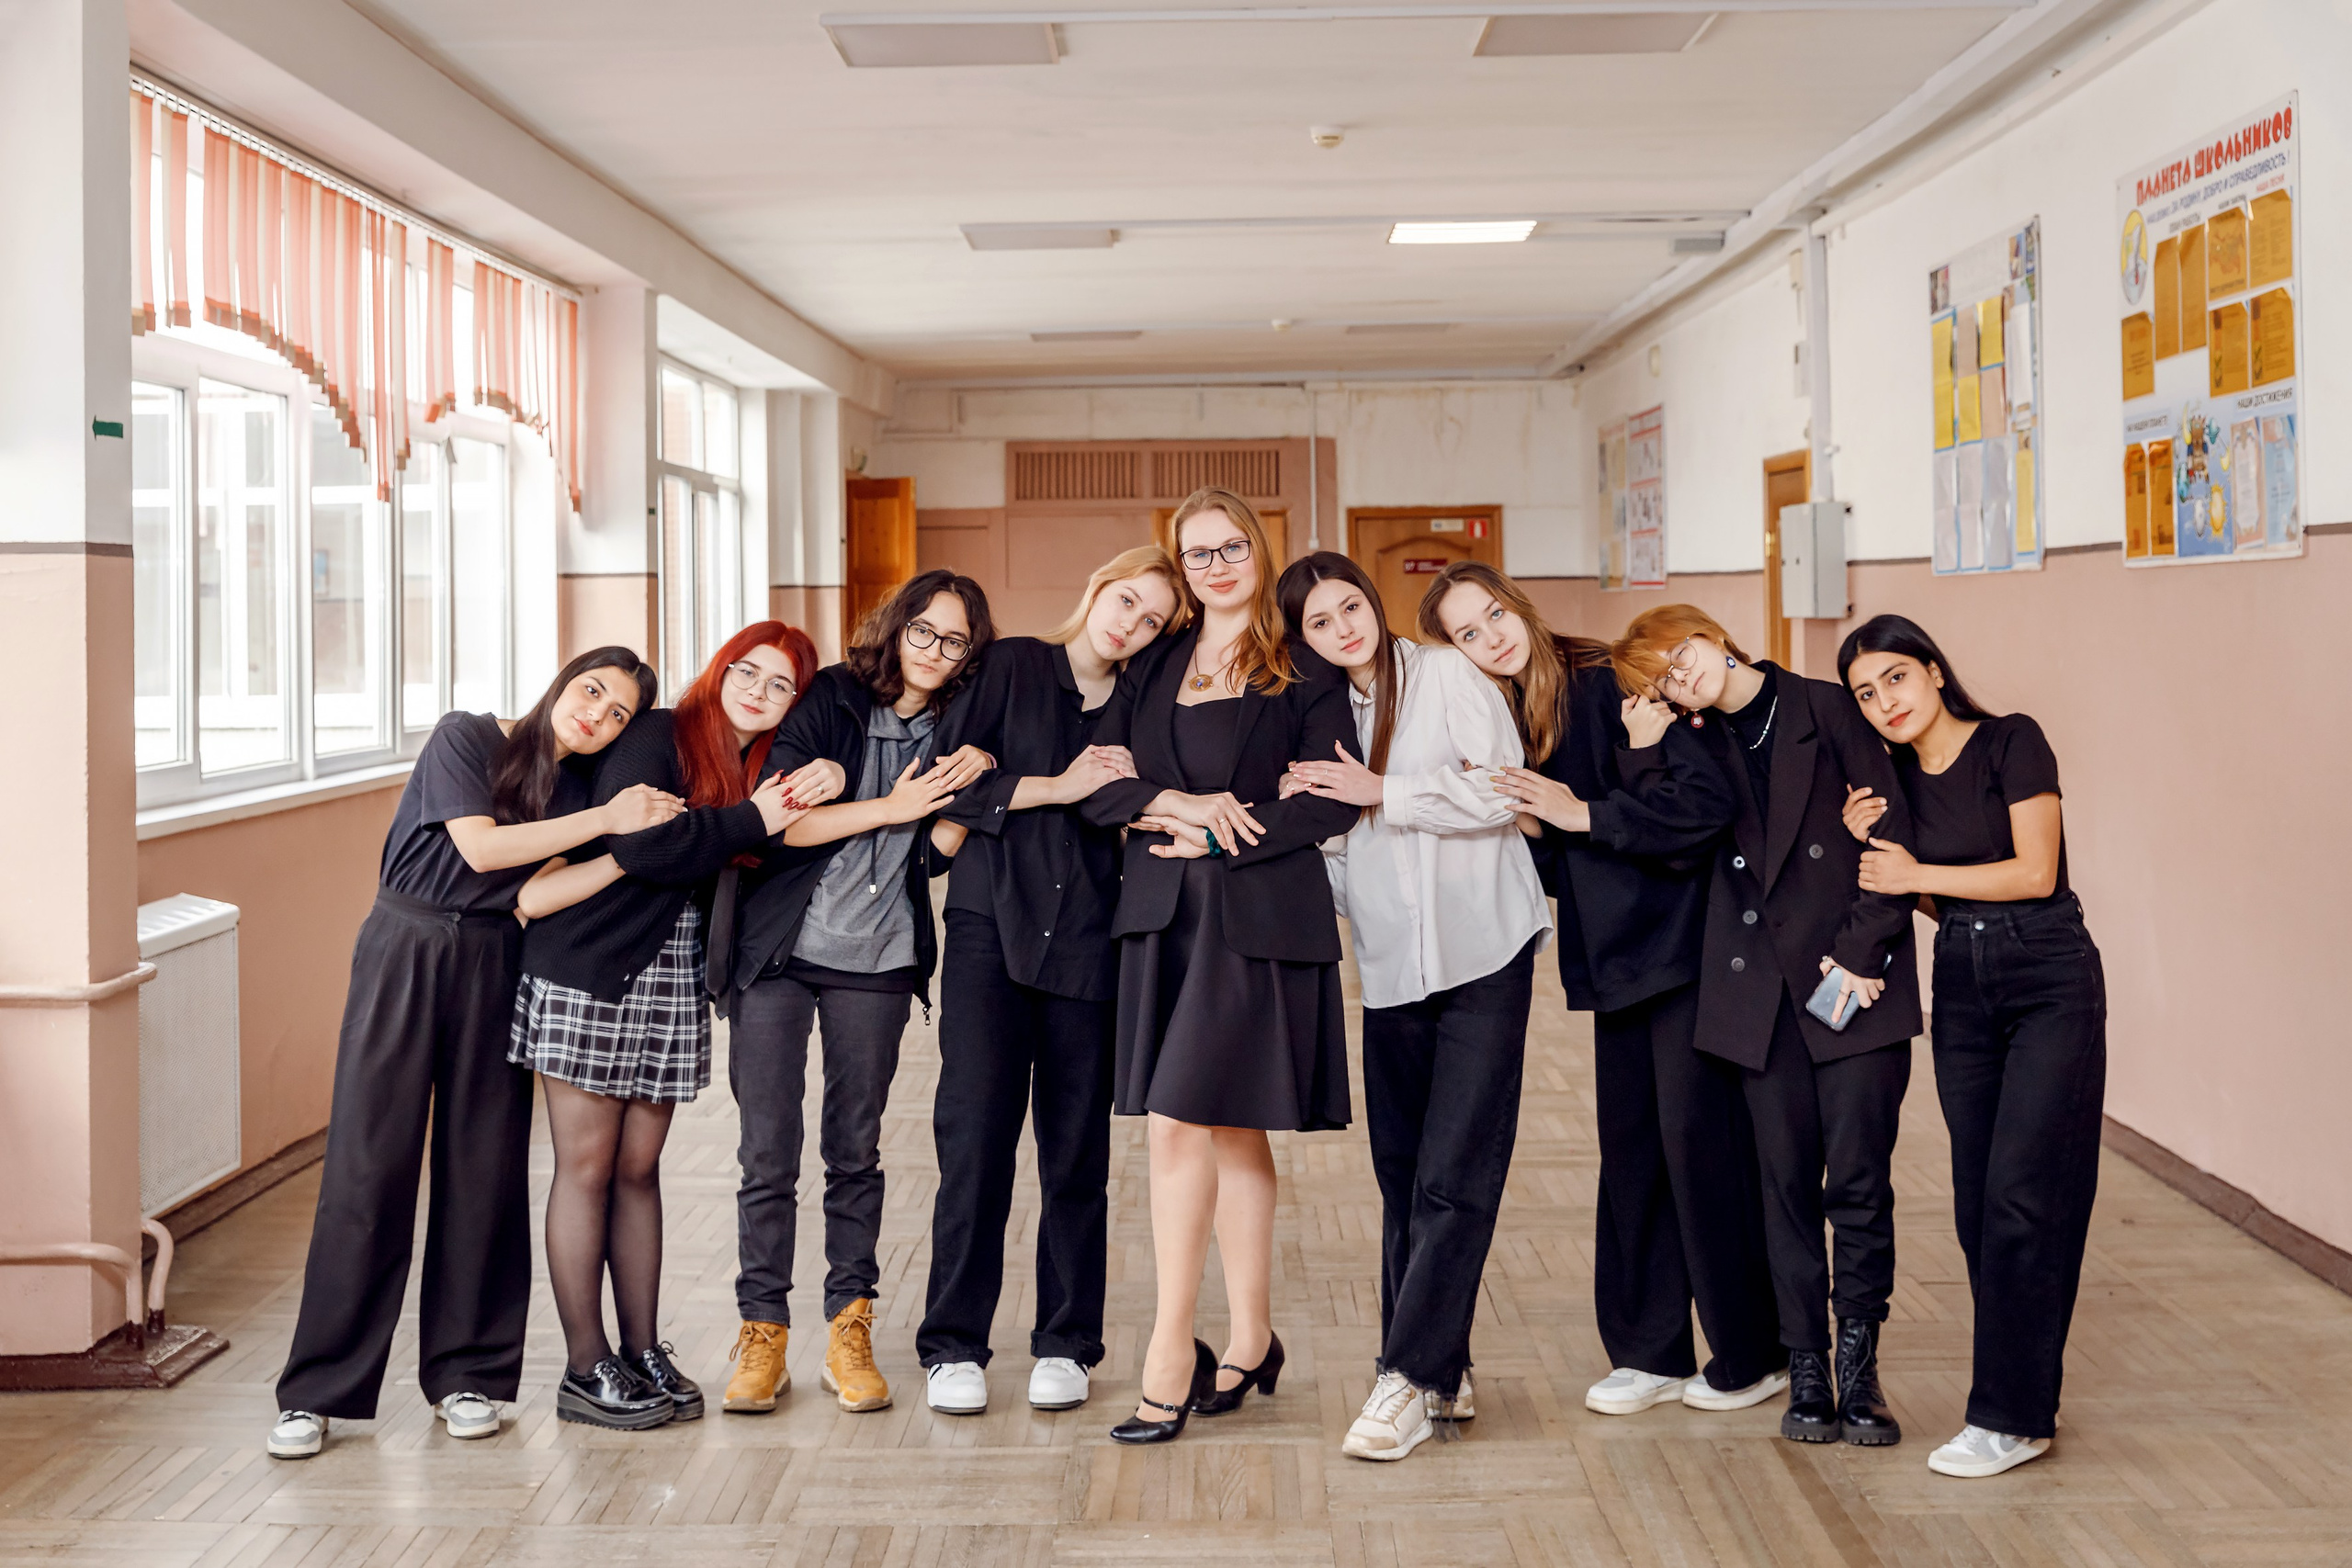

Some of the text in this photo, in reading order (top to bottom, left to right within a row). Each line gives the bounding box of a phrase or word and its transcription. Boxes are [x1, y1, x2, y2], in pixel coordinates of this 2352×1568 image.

[2136, 107, 2292, 207] ПЛАНЕТА ШКОЛЬНИКОВ
[2229, 152, 2286, 188] СПРАВЕДЛИВОСТЬ
[2254, 387, 2292, 407] ДОСТИЖЕНИЯ
